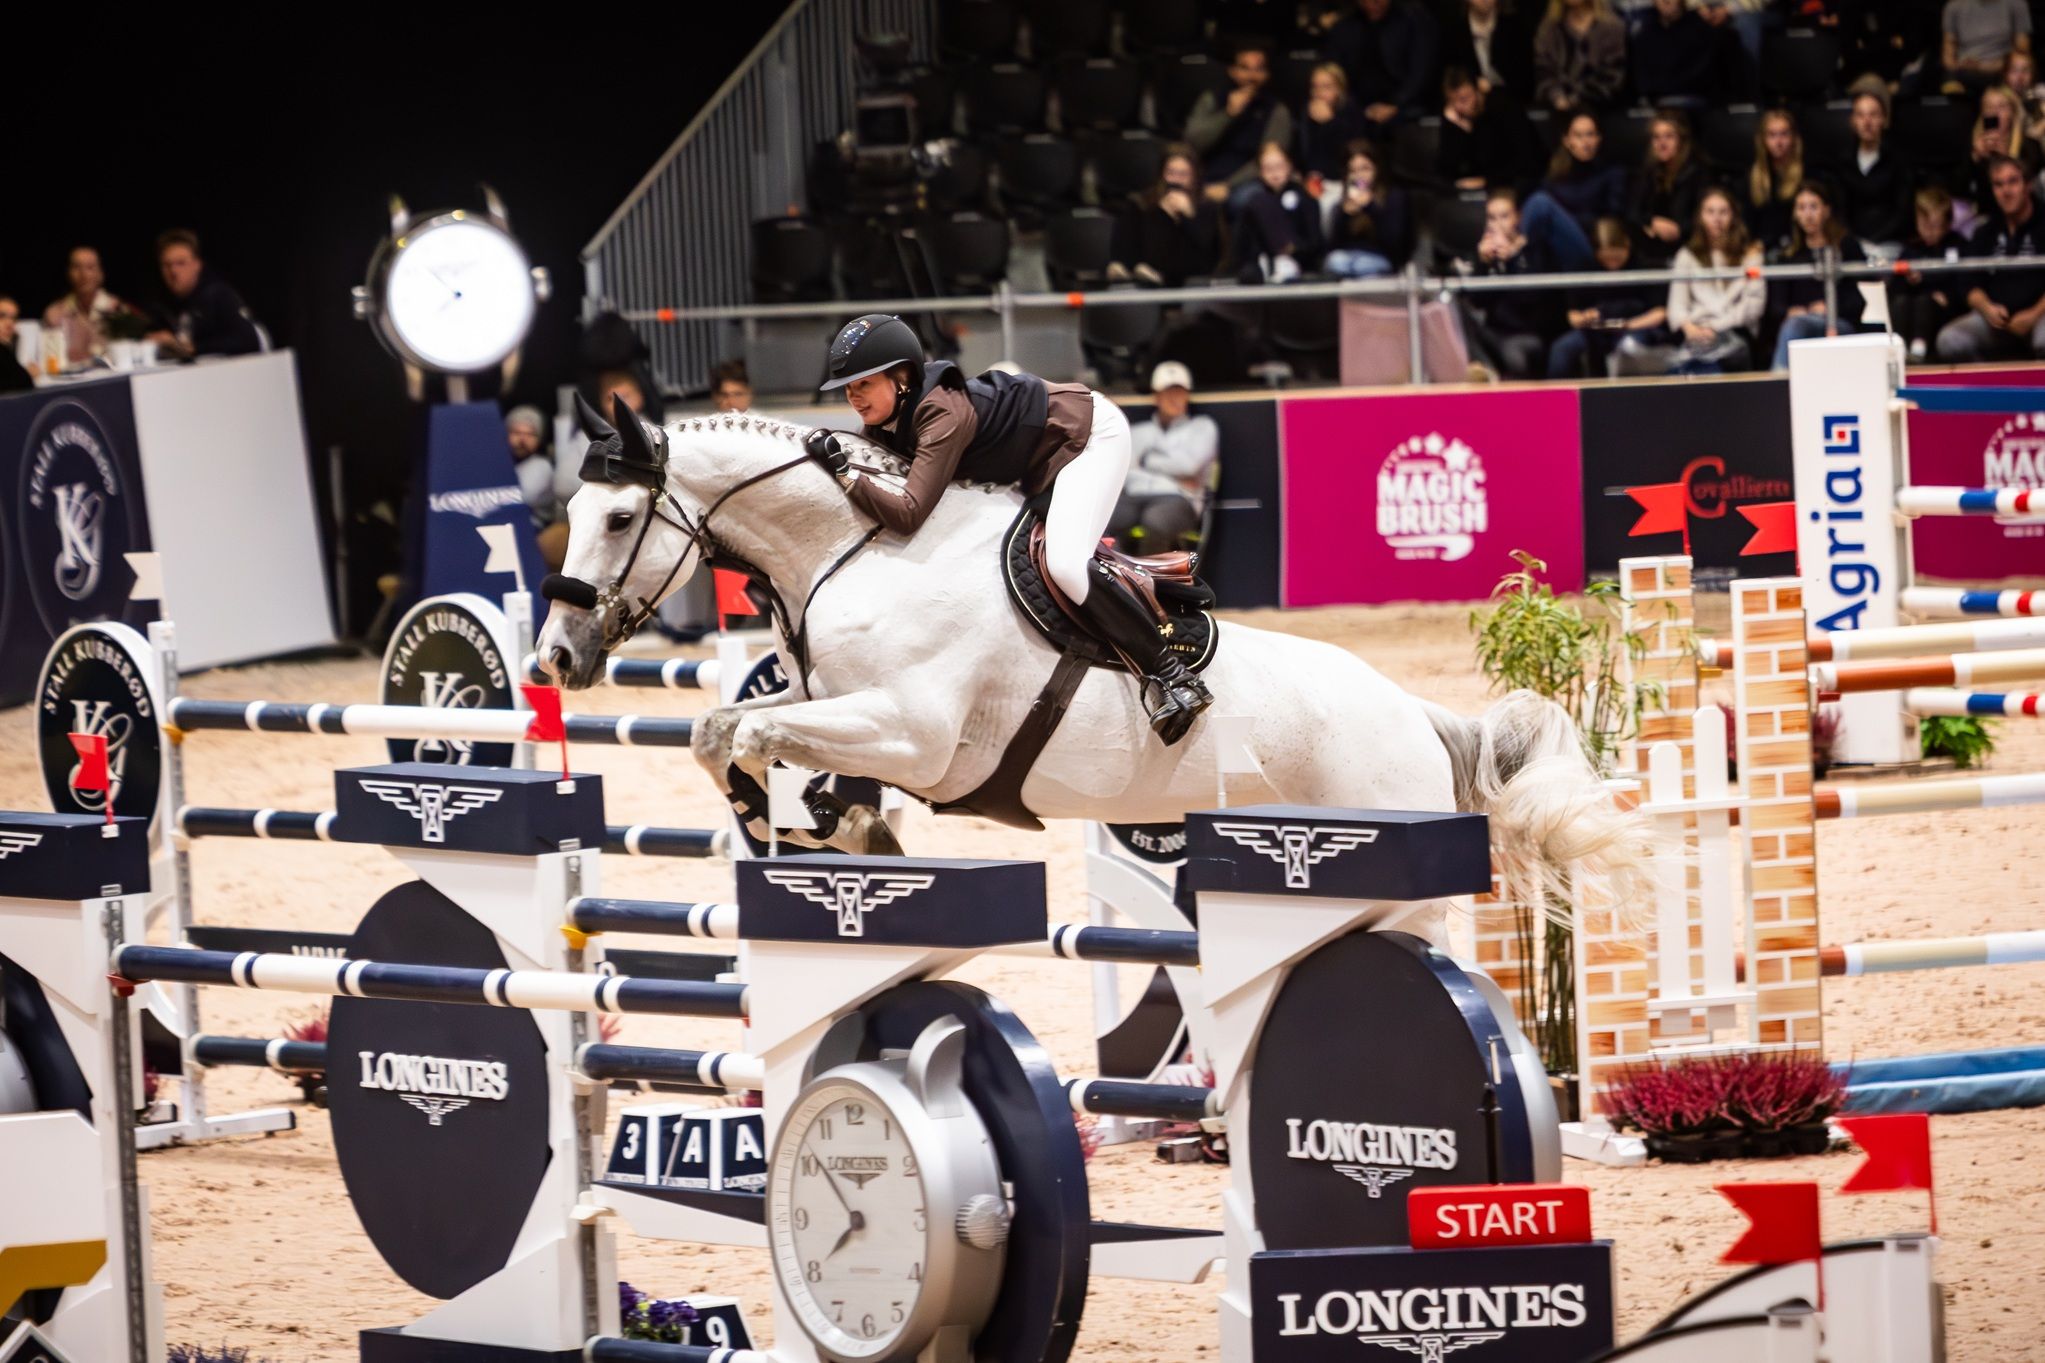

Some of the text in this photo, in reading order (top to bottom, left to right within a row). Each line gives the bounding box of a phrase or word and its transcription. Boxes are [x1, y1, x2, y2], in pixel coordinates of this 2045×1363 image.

[1377, 469, 1487, 503] MAGIC
[1377, 500, 1488, 536] BRUSH
[1814, 466, 1880, 632] Agria
[389, 624, 427, 688] STALL
[44, 652, 75, 715] STALL
[358, 1051, 510, 1101] LONGINES
[819, 1118, 832, 1141] 11
[845, 1104, 865, 1125] 12
[884, 1118, 891, 1141] 1
[621, 1121, 642, 1160] 3
[681, 1126, 705, 1163] A
[734, 1123, 763, 1162] A
[1285, 1118, 1459, 1171] LONGINES
[801, 1154, 819, 1177] 10
[903, 1155, 919, 1177] 2
[795, 1208, 808, 1231] 9
[914, 1208, 926, 1232] 3
[1436, 1200, 1563, 1239] START
[807, 1260, 822, 1283] 8
[907, 1262, 921, 1283] 4
[831, 1300, 844, 1323] 7
[861, 1313, 876, 1338] 6
[891, 1301, 904, 1324] 5
[1278, 1284, 1586, 1336] LONGINES
[706, 1316, 730, 1349] 9
